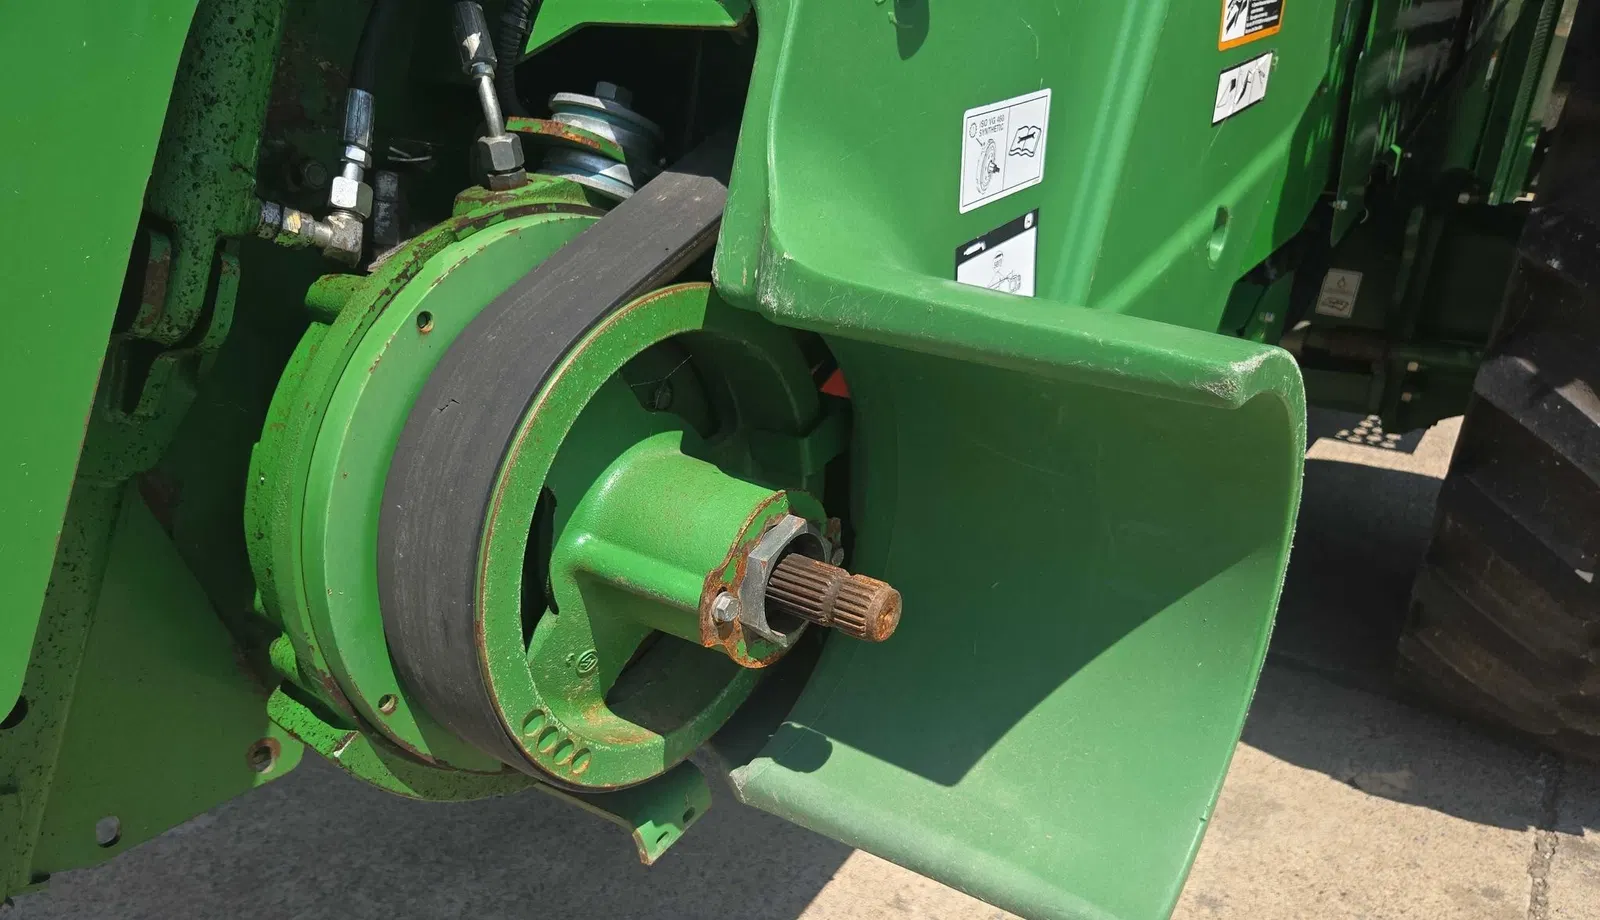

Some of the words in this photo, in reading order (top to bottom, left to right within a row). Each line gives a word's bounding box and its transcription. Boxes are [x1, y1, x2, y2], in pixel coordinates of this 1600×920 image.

[979, 118, 988, 128] ISO
[988, 116, 996, 125] VG
[979, 123, 1004, 137] SYNTHETIC
